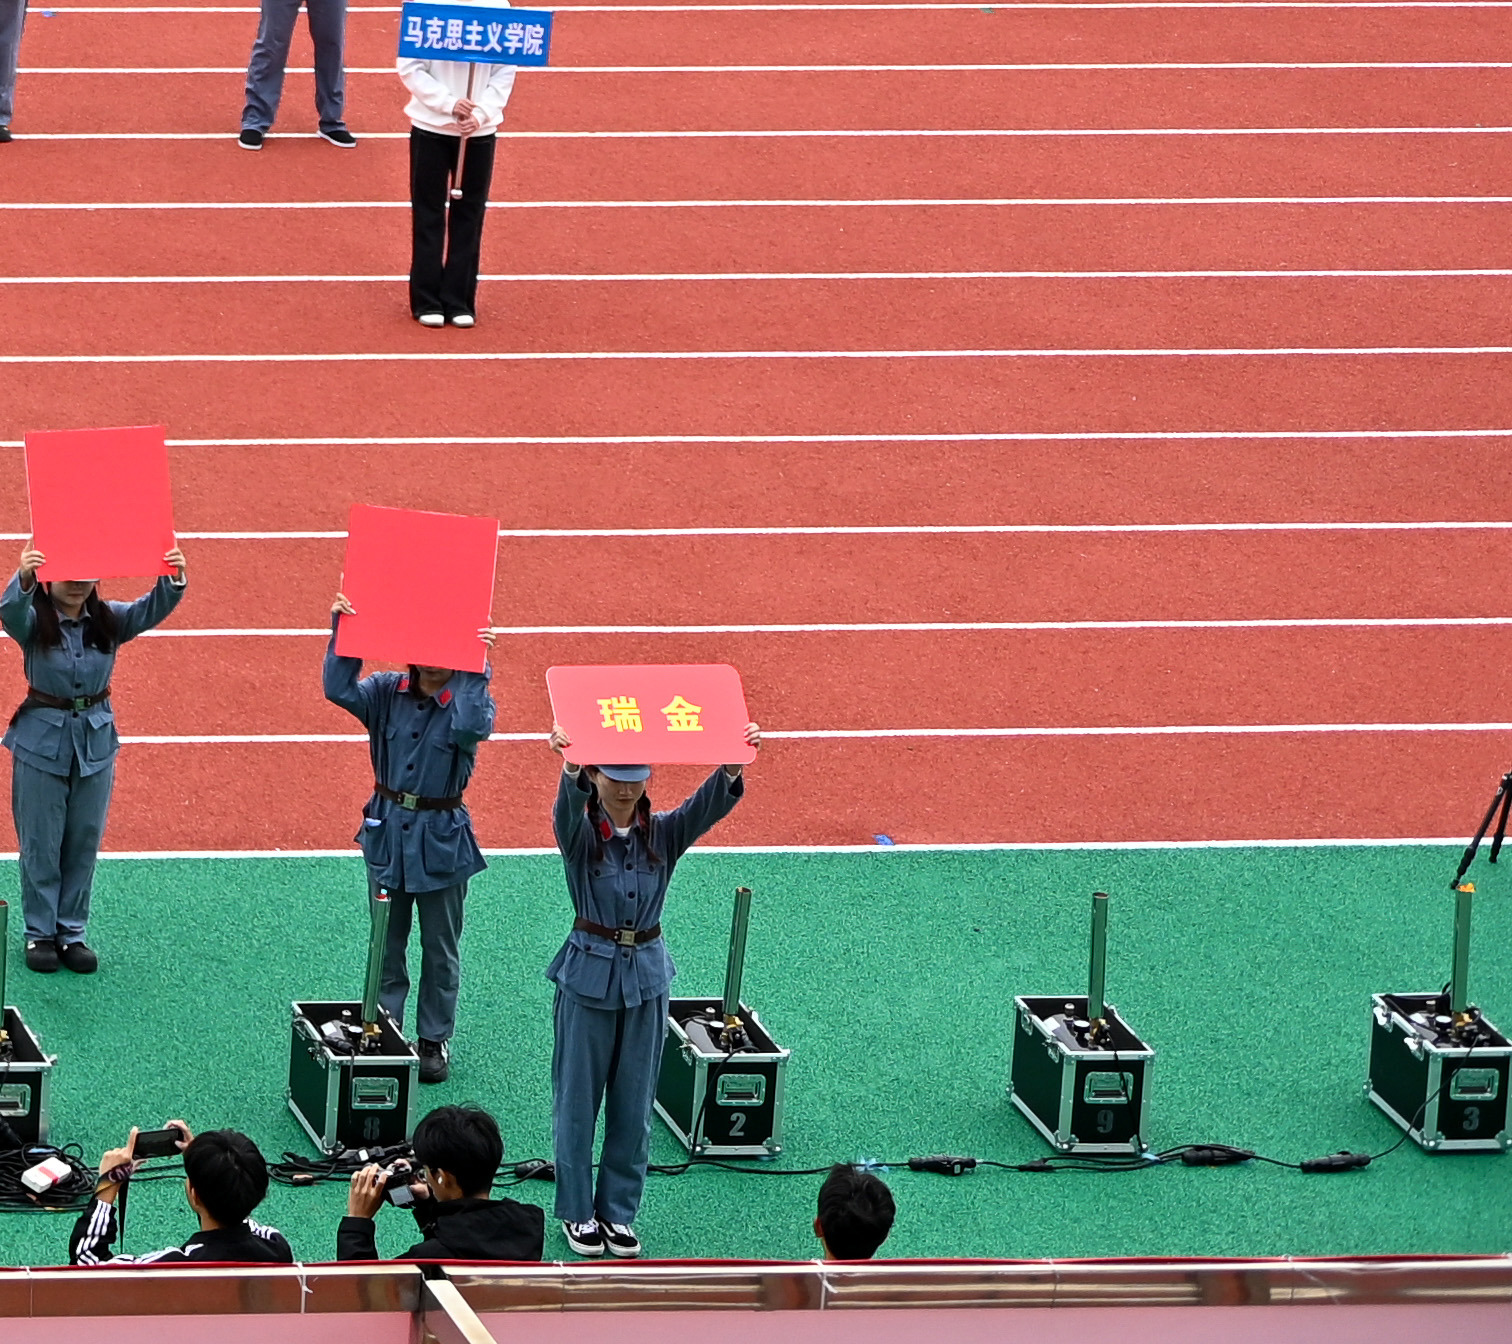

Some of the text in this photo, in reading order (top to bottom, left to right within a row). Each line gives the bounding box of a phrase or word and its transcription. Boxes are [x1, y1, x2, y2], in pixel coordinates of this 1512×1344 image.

[404, 15, 546, 57] 马克思主义学院
[599, 695, 705, 734] 瑞金
[729, 1112, 746, 1137] 2
[1097, 1109, 1114, 1134] 9
[1462, 1106, 1480, 1131] 3
